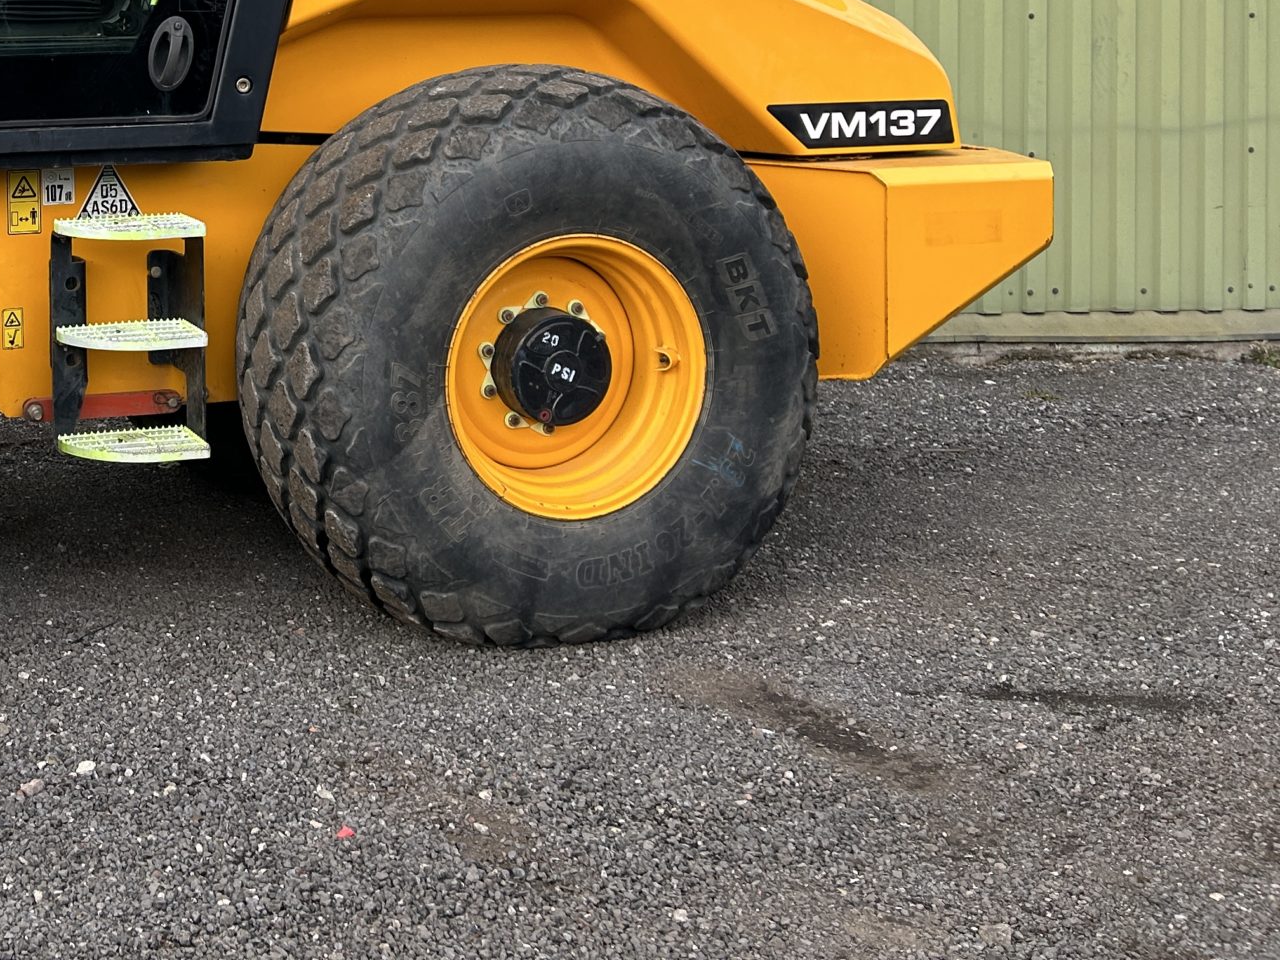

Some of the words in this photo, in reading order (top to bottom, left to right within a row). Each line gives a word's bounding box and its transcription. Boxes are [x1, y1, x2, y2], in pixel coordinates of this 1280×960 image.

[799, 108, 942, 140] VM137
[45, 184, 63, 202] 107
[723, 255, 773, 337] BKT
[541, 331, 560, 347] 20
[551, 362, 576, 383] PSI
